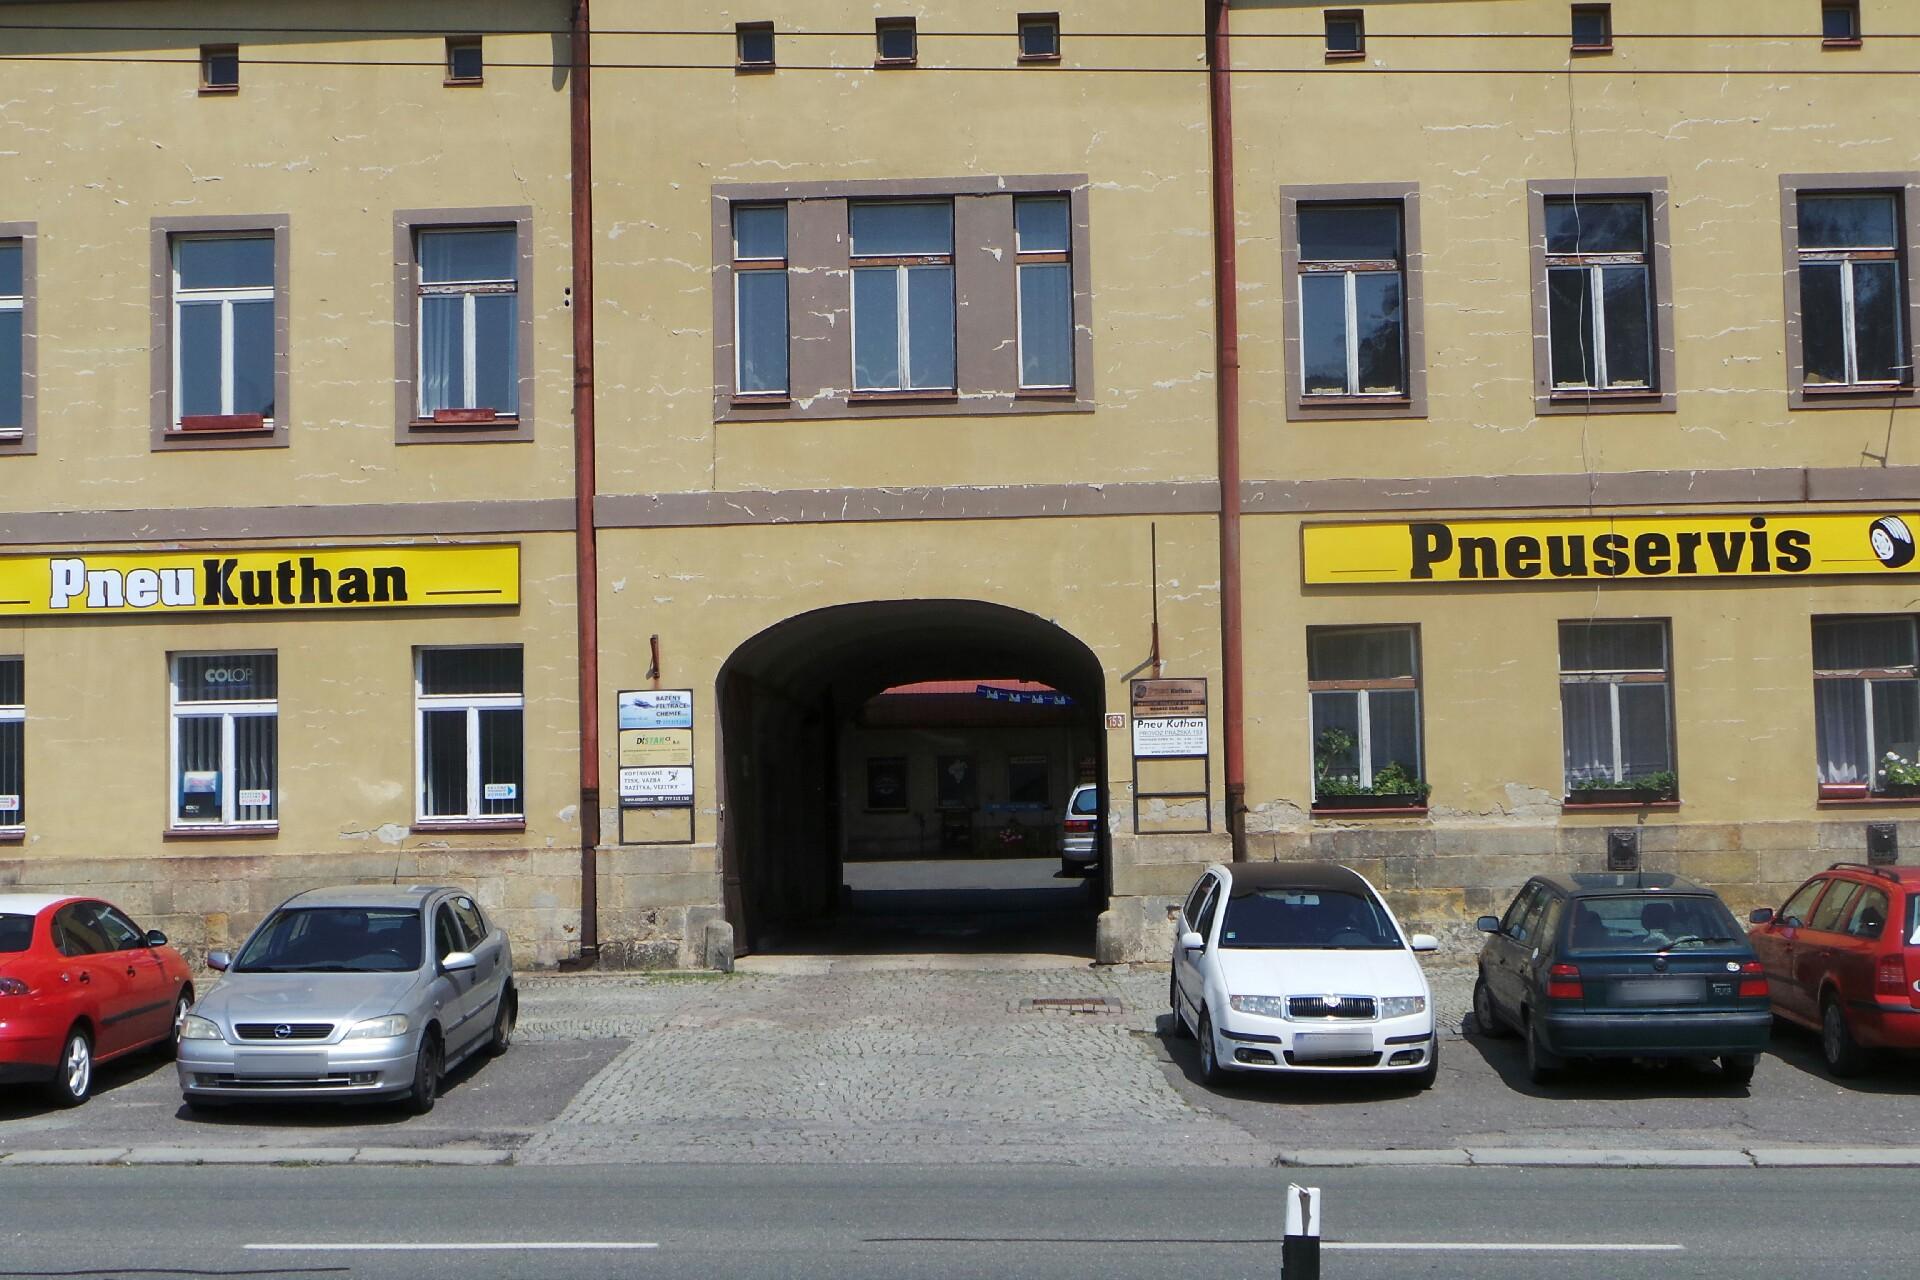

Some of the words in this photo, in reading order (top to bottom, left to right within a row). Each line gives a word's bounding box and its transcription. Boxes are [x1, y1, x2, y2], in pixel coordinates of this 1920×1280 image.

[1408, 517, 1812, 580] Pneuservis
[50, 557, 195, 609] Pneu
[203, 557, 408, 606] Kuthan
[1108, 715, 1123, 728] 153
[1137, 719, 1163, 729] Pneu
[1166, 718, 1204, 729] Kuthan
